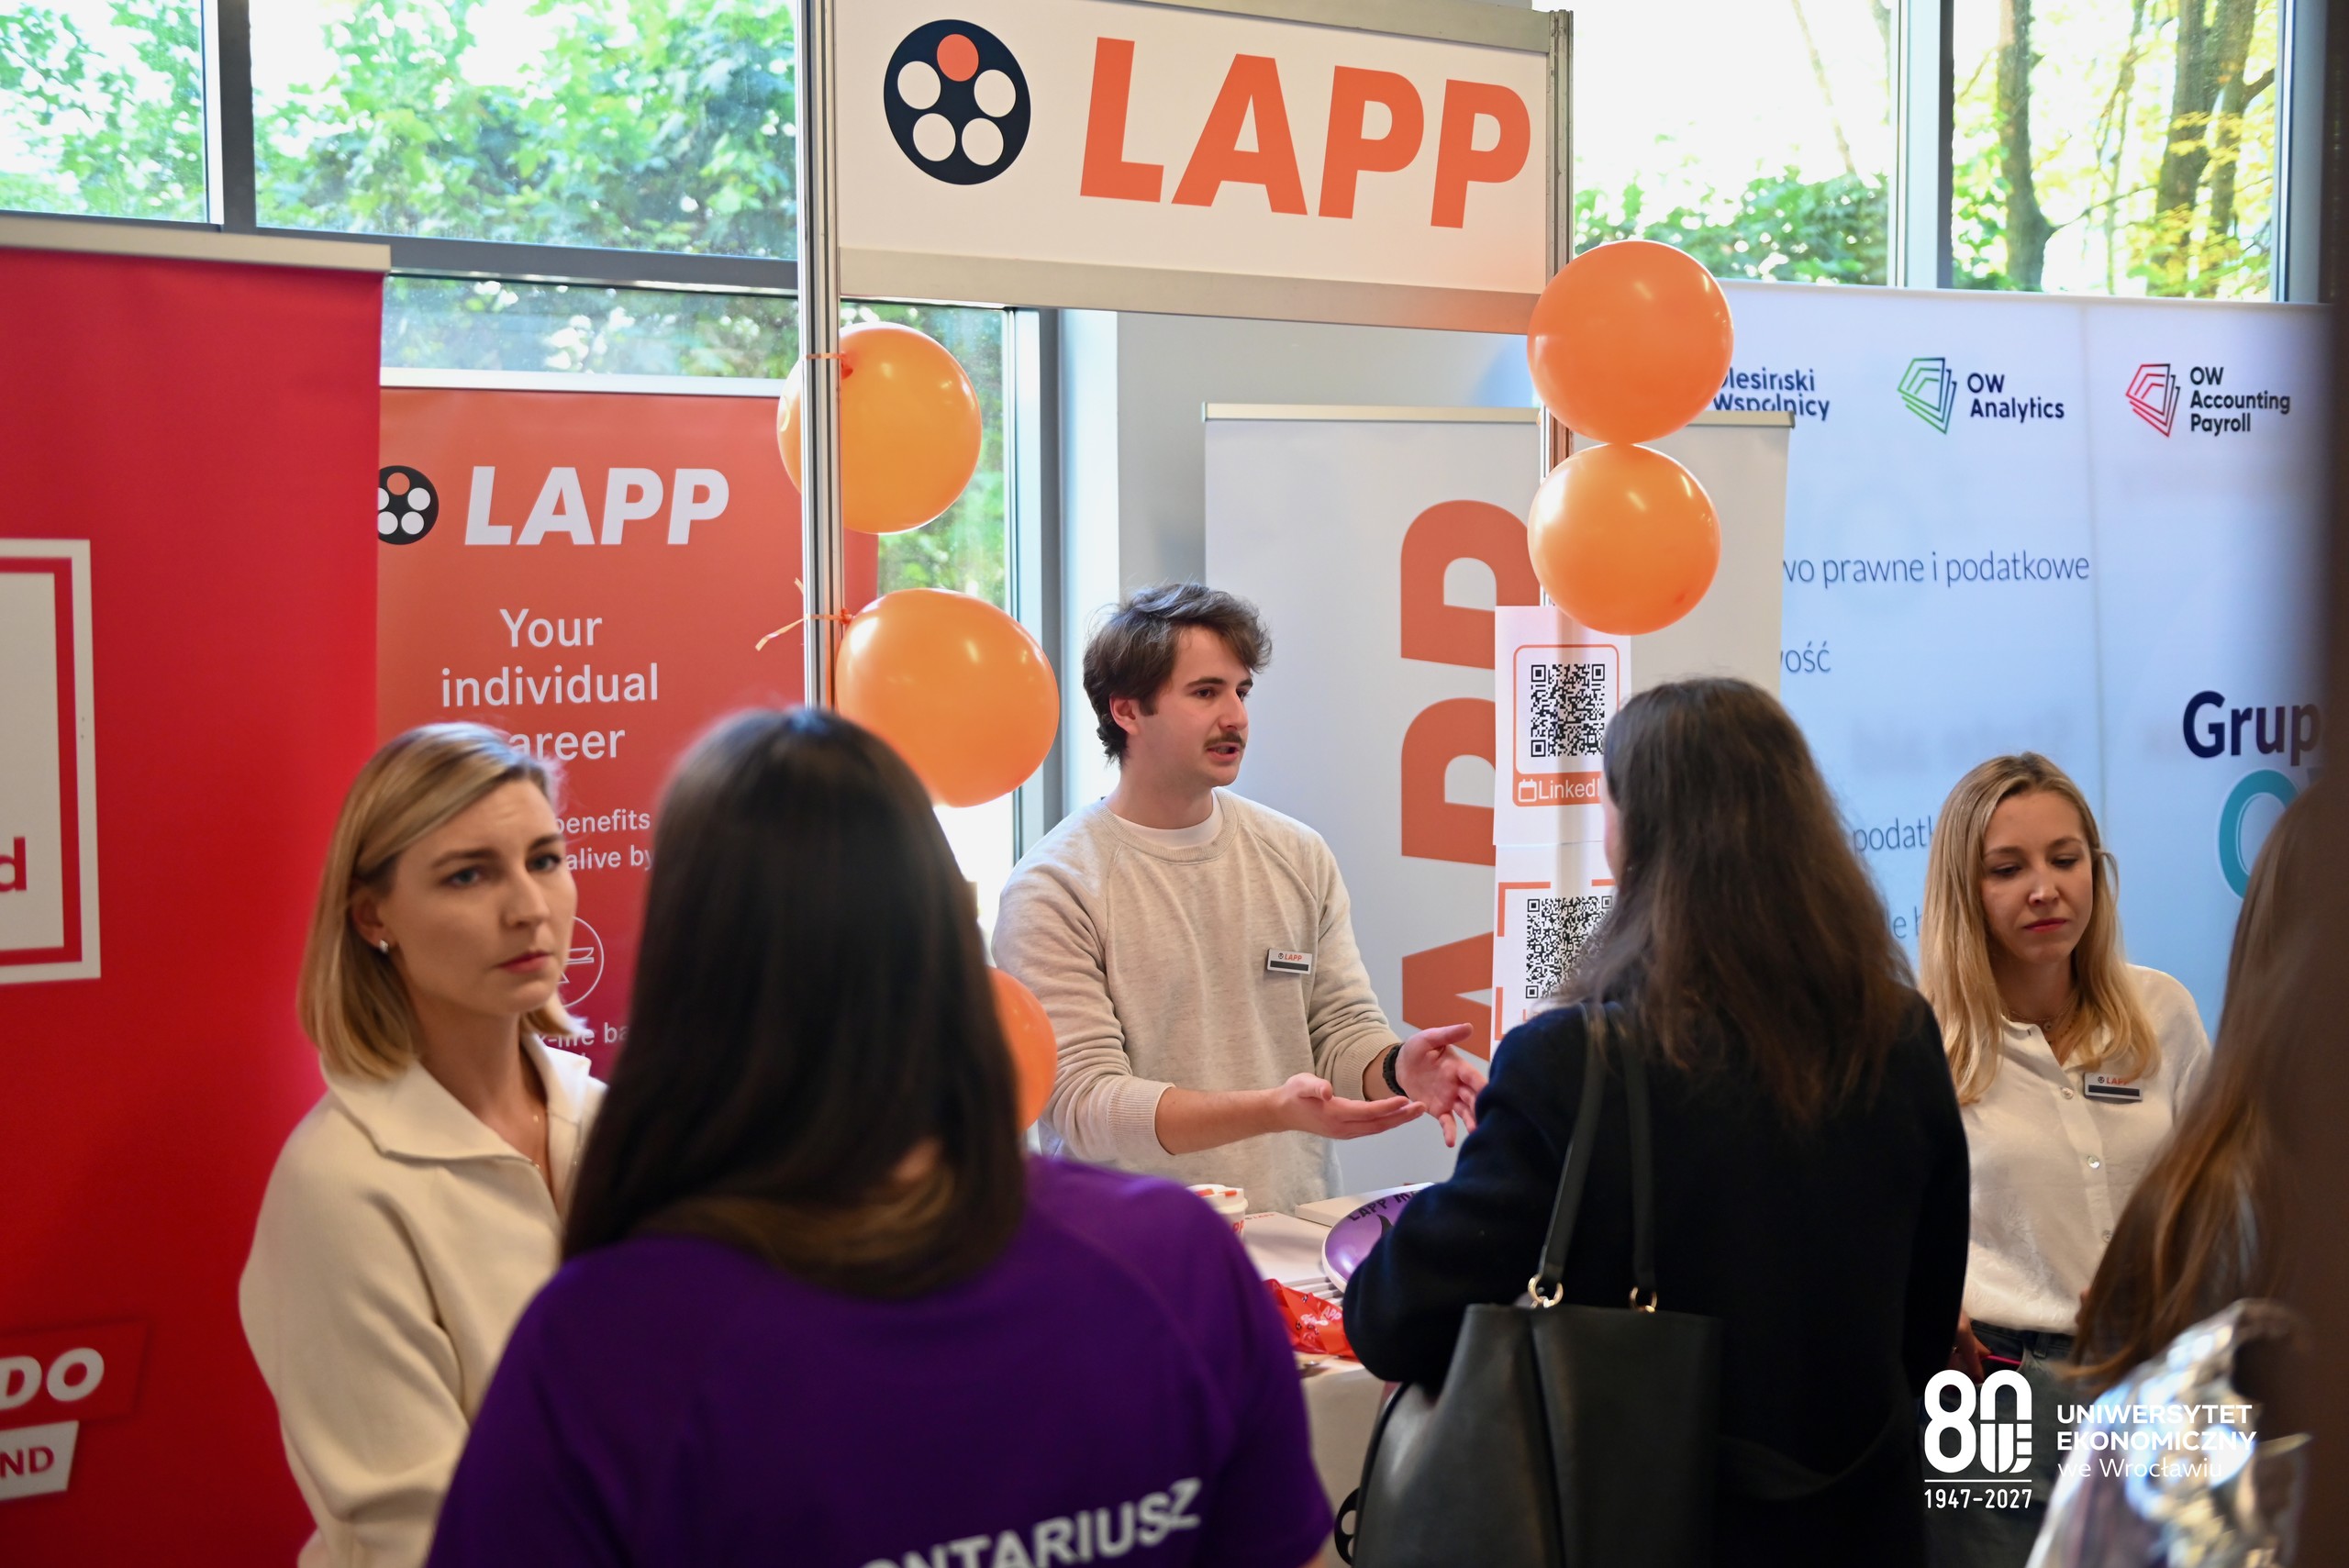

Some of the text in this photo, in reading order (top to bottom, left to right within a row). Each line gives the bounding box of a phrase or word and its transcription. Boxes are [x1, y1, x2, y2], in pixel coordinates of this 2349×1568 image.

[1080, 37, 1531, 228] LAPP
[1967, 372, 2006, 394] OW
[2189, 366, 2224, 385] OW
[1970, 395, 2065, 423] Analytics
[2189, 389, 2290, 415] Accounting
[2190, 412, 2251, 437] Payroll
[464, 465, 729, 546] LAPP
[1822, 559, 1924, 589] prawne
[1932, 550, 1938, 581] i
[1945, 549, 2090, 588] podatkowe
[499, 608, 602, 648] Your
[1780, 640, 1831, 673] ość
[441, 662, 658, 707] individual
[2183, 690, 2321, 766] Grup
[507, 729, 626, 761] areer
[1539, 778, 1601, 799] LinkedI
[1285, 953, 1302, 962] LAPP
[1349, 1198, 1387, 1221] LAPP
[0, 1347, 105, 1410] DO
